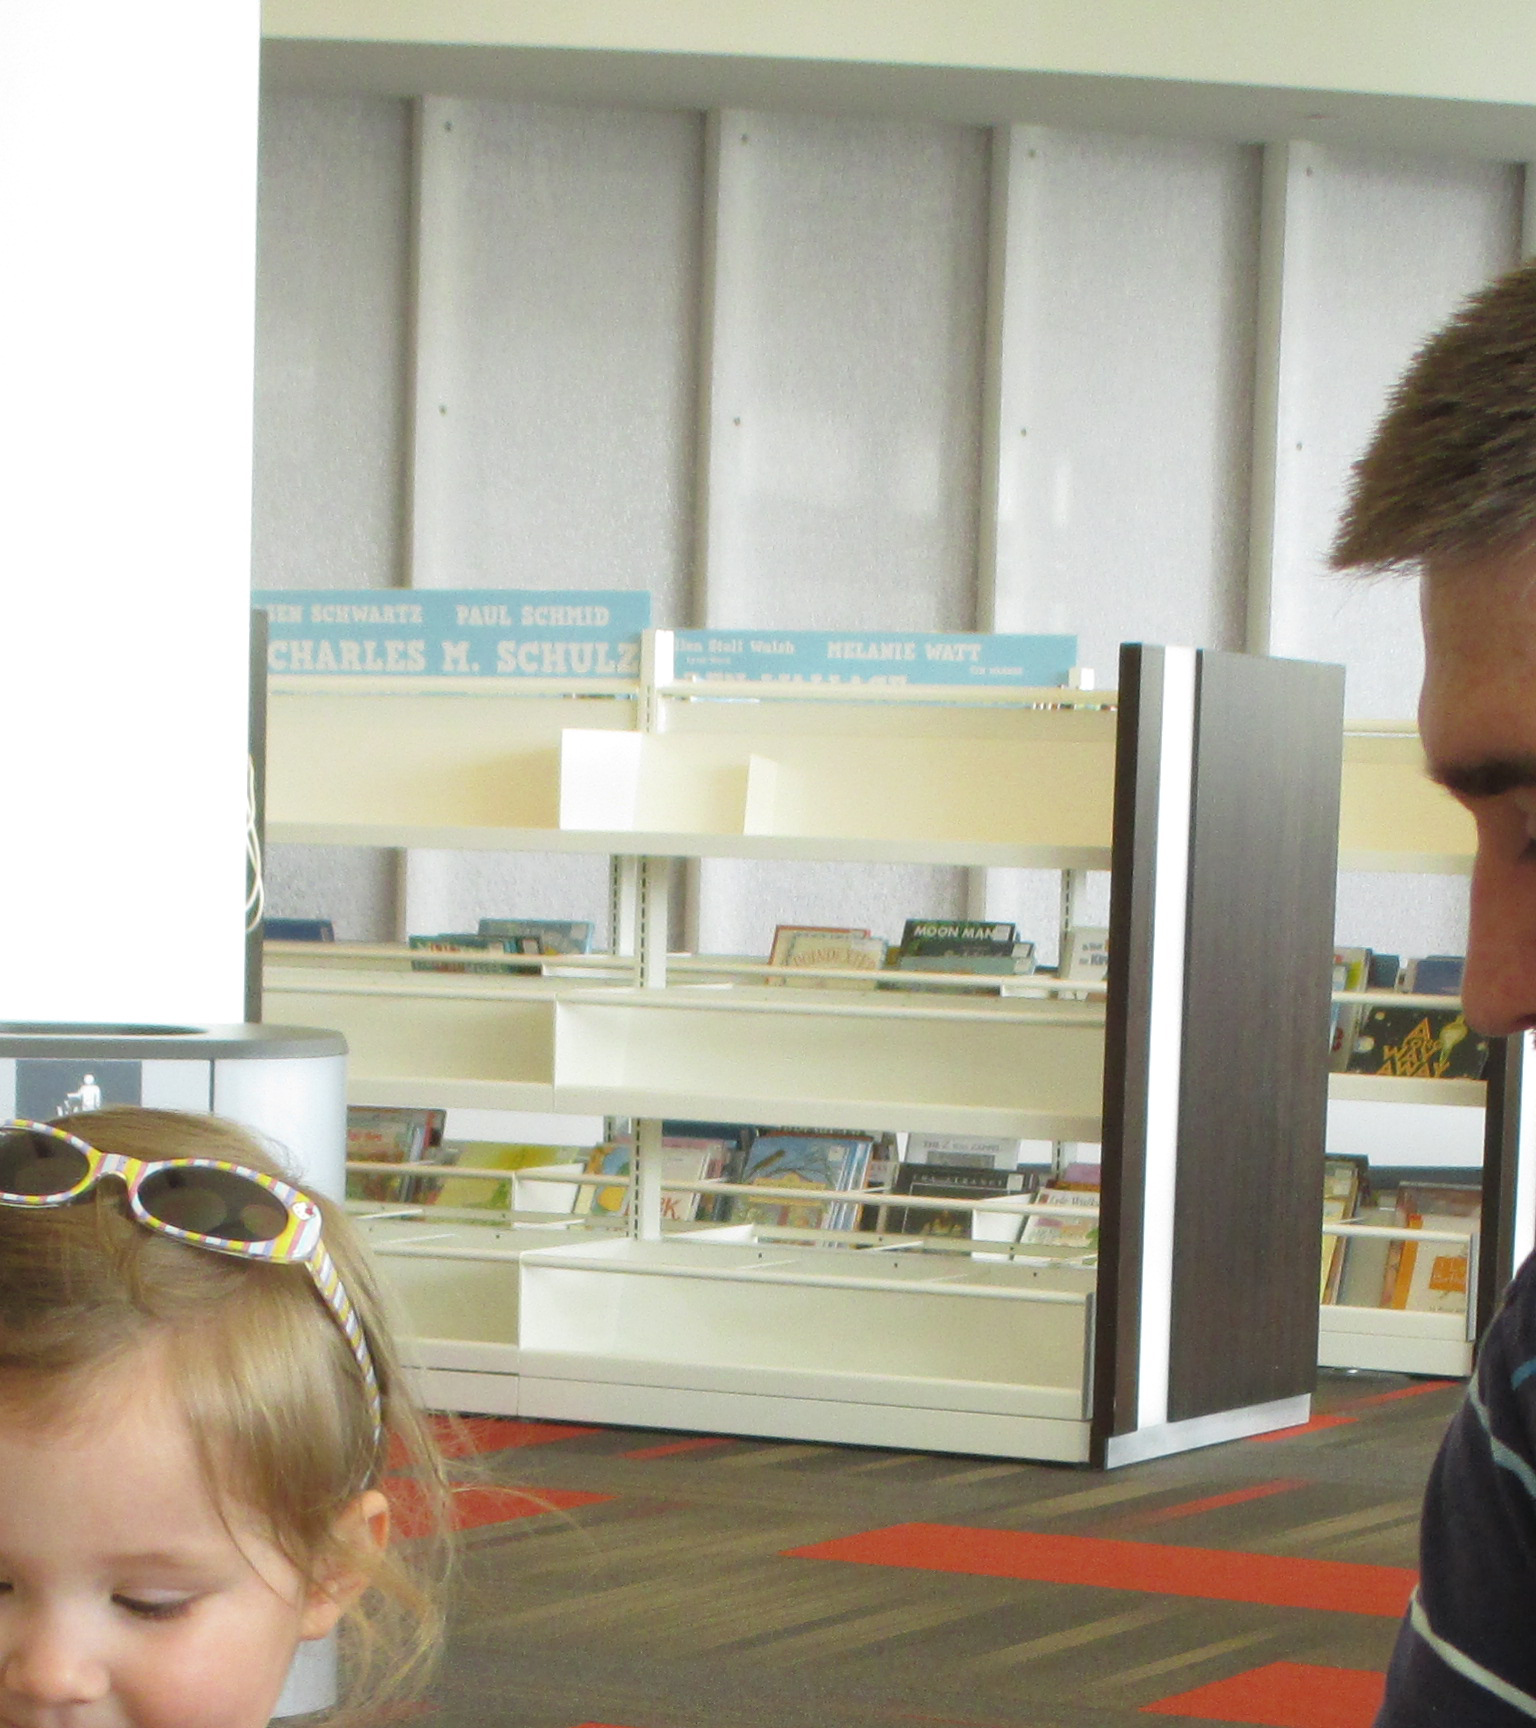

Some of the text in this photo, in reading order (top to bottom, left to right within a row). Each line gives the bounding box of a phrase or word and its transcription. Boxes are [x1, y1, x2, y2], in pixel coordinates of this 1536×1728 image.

[311, 604, 423, 623] SCHWARTZ
[456, 605, 511, 625] PAUL
[521, 606, 610, 626] SCHMID
[268, 640, 426, 670] CHARLES
[441, 640, 480, 672] M.
[497, 640, 641, 673] SCHULZ
[827, 642, 916, 660] MELANIE
[925, 643, 982, 661] WATT
[913, 924, 995, 939] MOON MAN
[1383, 1042, 1440, 1063] WAY
[1375, 1059, 1451, 1078] AWAY
